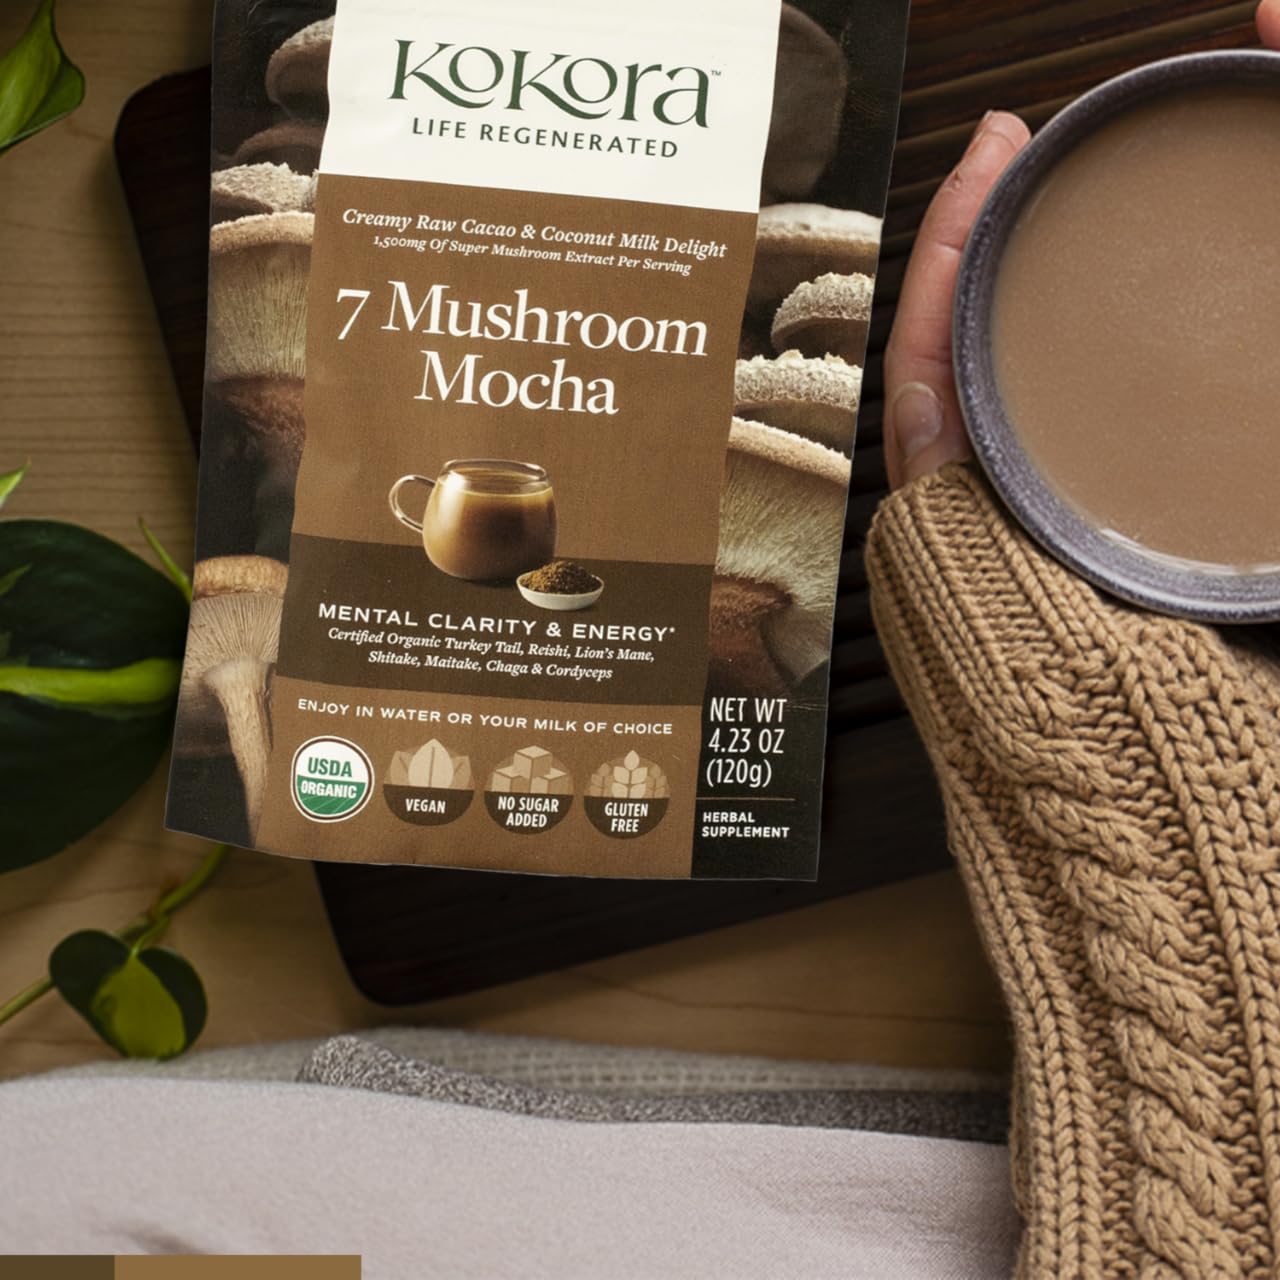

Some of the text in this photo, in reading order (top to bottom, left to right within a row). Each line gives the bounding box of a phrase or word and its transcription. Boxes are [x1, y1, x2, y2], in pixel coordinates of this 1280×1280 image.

[411, 117, 679, 159] LIFE REGENERATED
[342, 208, 729, 261] Creamy Raw Cacao & Coconut Milk Delight
[373, 235, 693, 277] 1,500mg Of Super Mushroom Extract Per Serving
[335, 280, 709, 357] 7 Mushroom
[413, 349, 620, 416] Mocha
[318, 602, 419, 627] MENTAL
[427, 613, 537, 636] CLARITY
[545, 621, 562, 638] &
[328, 627, 385, 645] Certified
[386, 632, 441, 649] Organic
[444, 637, 492, 655] Turkey
[495, 641, 525, 656] Tail,
[527, 643, 572, 659] Reishi,
[616, 648, 655, 663] Mane,
[368, 650, 613, 682] Shitake, Maitake, Chaga & Cordyceps
[297, 698, 673, 735] ENJOY IN WATER OR YOUR MILK OF CHOICE
[709, 696, 788, 724] NET WT
[708, 727, 785, 754] 4.23 OZ
[307, 756, 353, 778] USDA
[706, 758, 772, 788] (120g)
[300, 780, 358, 799] ORGANIC
[405, 797, 446, 814] VEGAN
[497, 795, 560, 813] NO SUGAR
[604, 802, 649, 817] GLUTEN
[702, 811, 756, 823] HERBAL
[505, 812, 548, 828] ADDED
[610, 818, 640, 833] FREE
[701, 826, 790, 839] SUPPLEMENT
